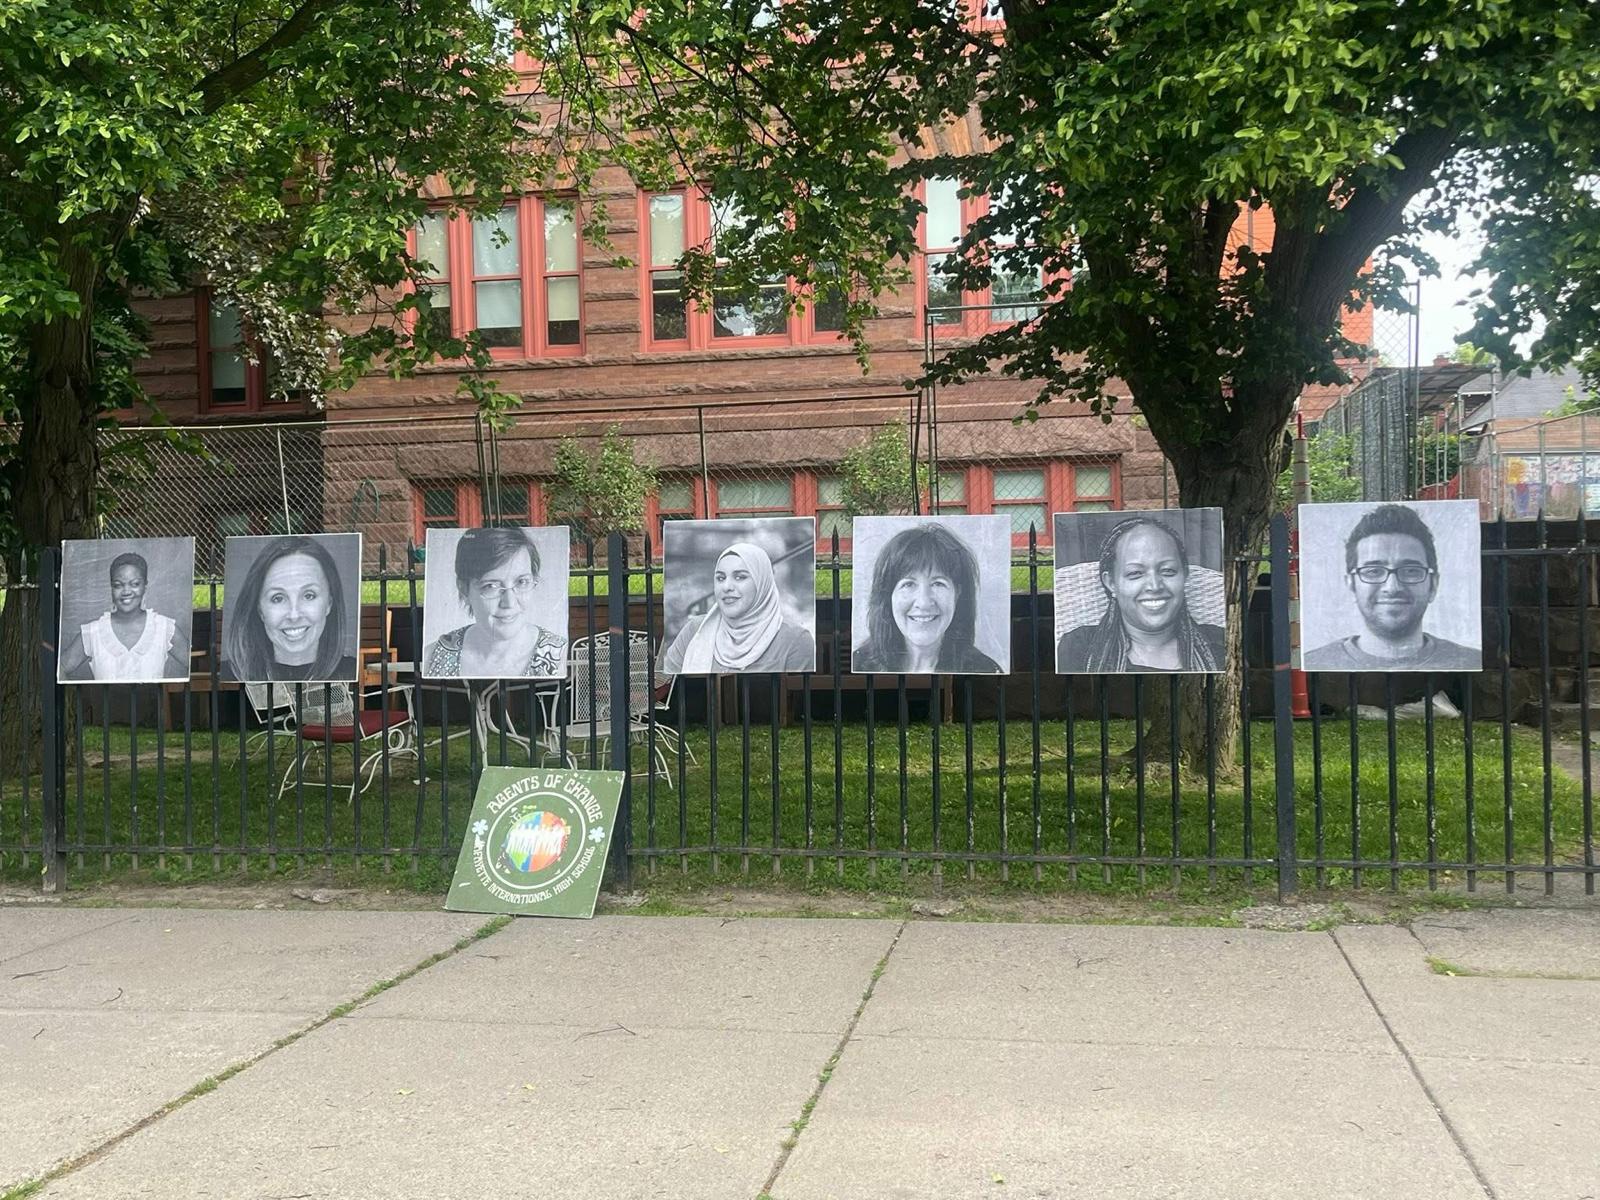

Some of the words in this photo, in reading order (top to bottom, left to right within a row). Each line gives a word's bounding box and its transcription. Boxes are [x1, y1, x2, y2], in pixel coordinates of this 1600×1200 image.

[487, 775, 540, 814] AGENTS
[544, 774, 563, 788] OF
[564, 779, 603, 823] CHANGE
[488, 882, 552, 904] INTERNATIONAL
[553, 876, 574, 895] HIGH
[573, 846, 595, 879] SCHOOL
